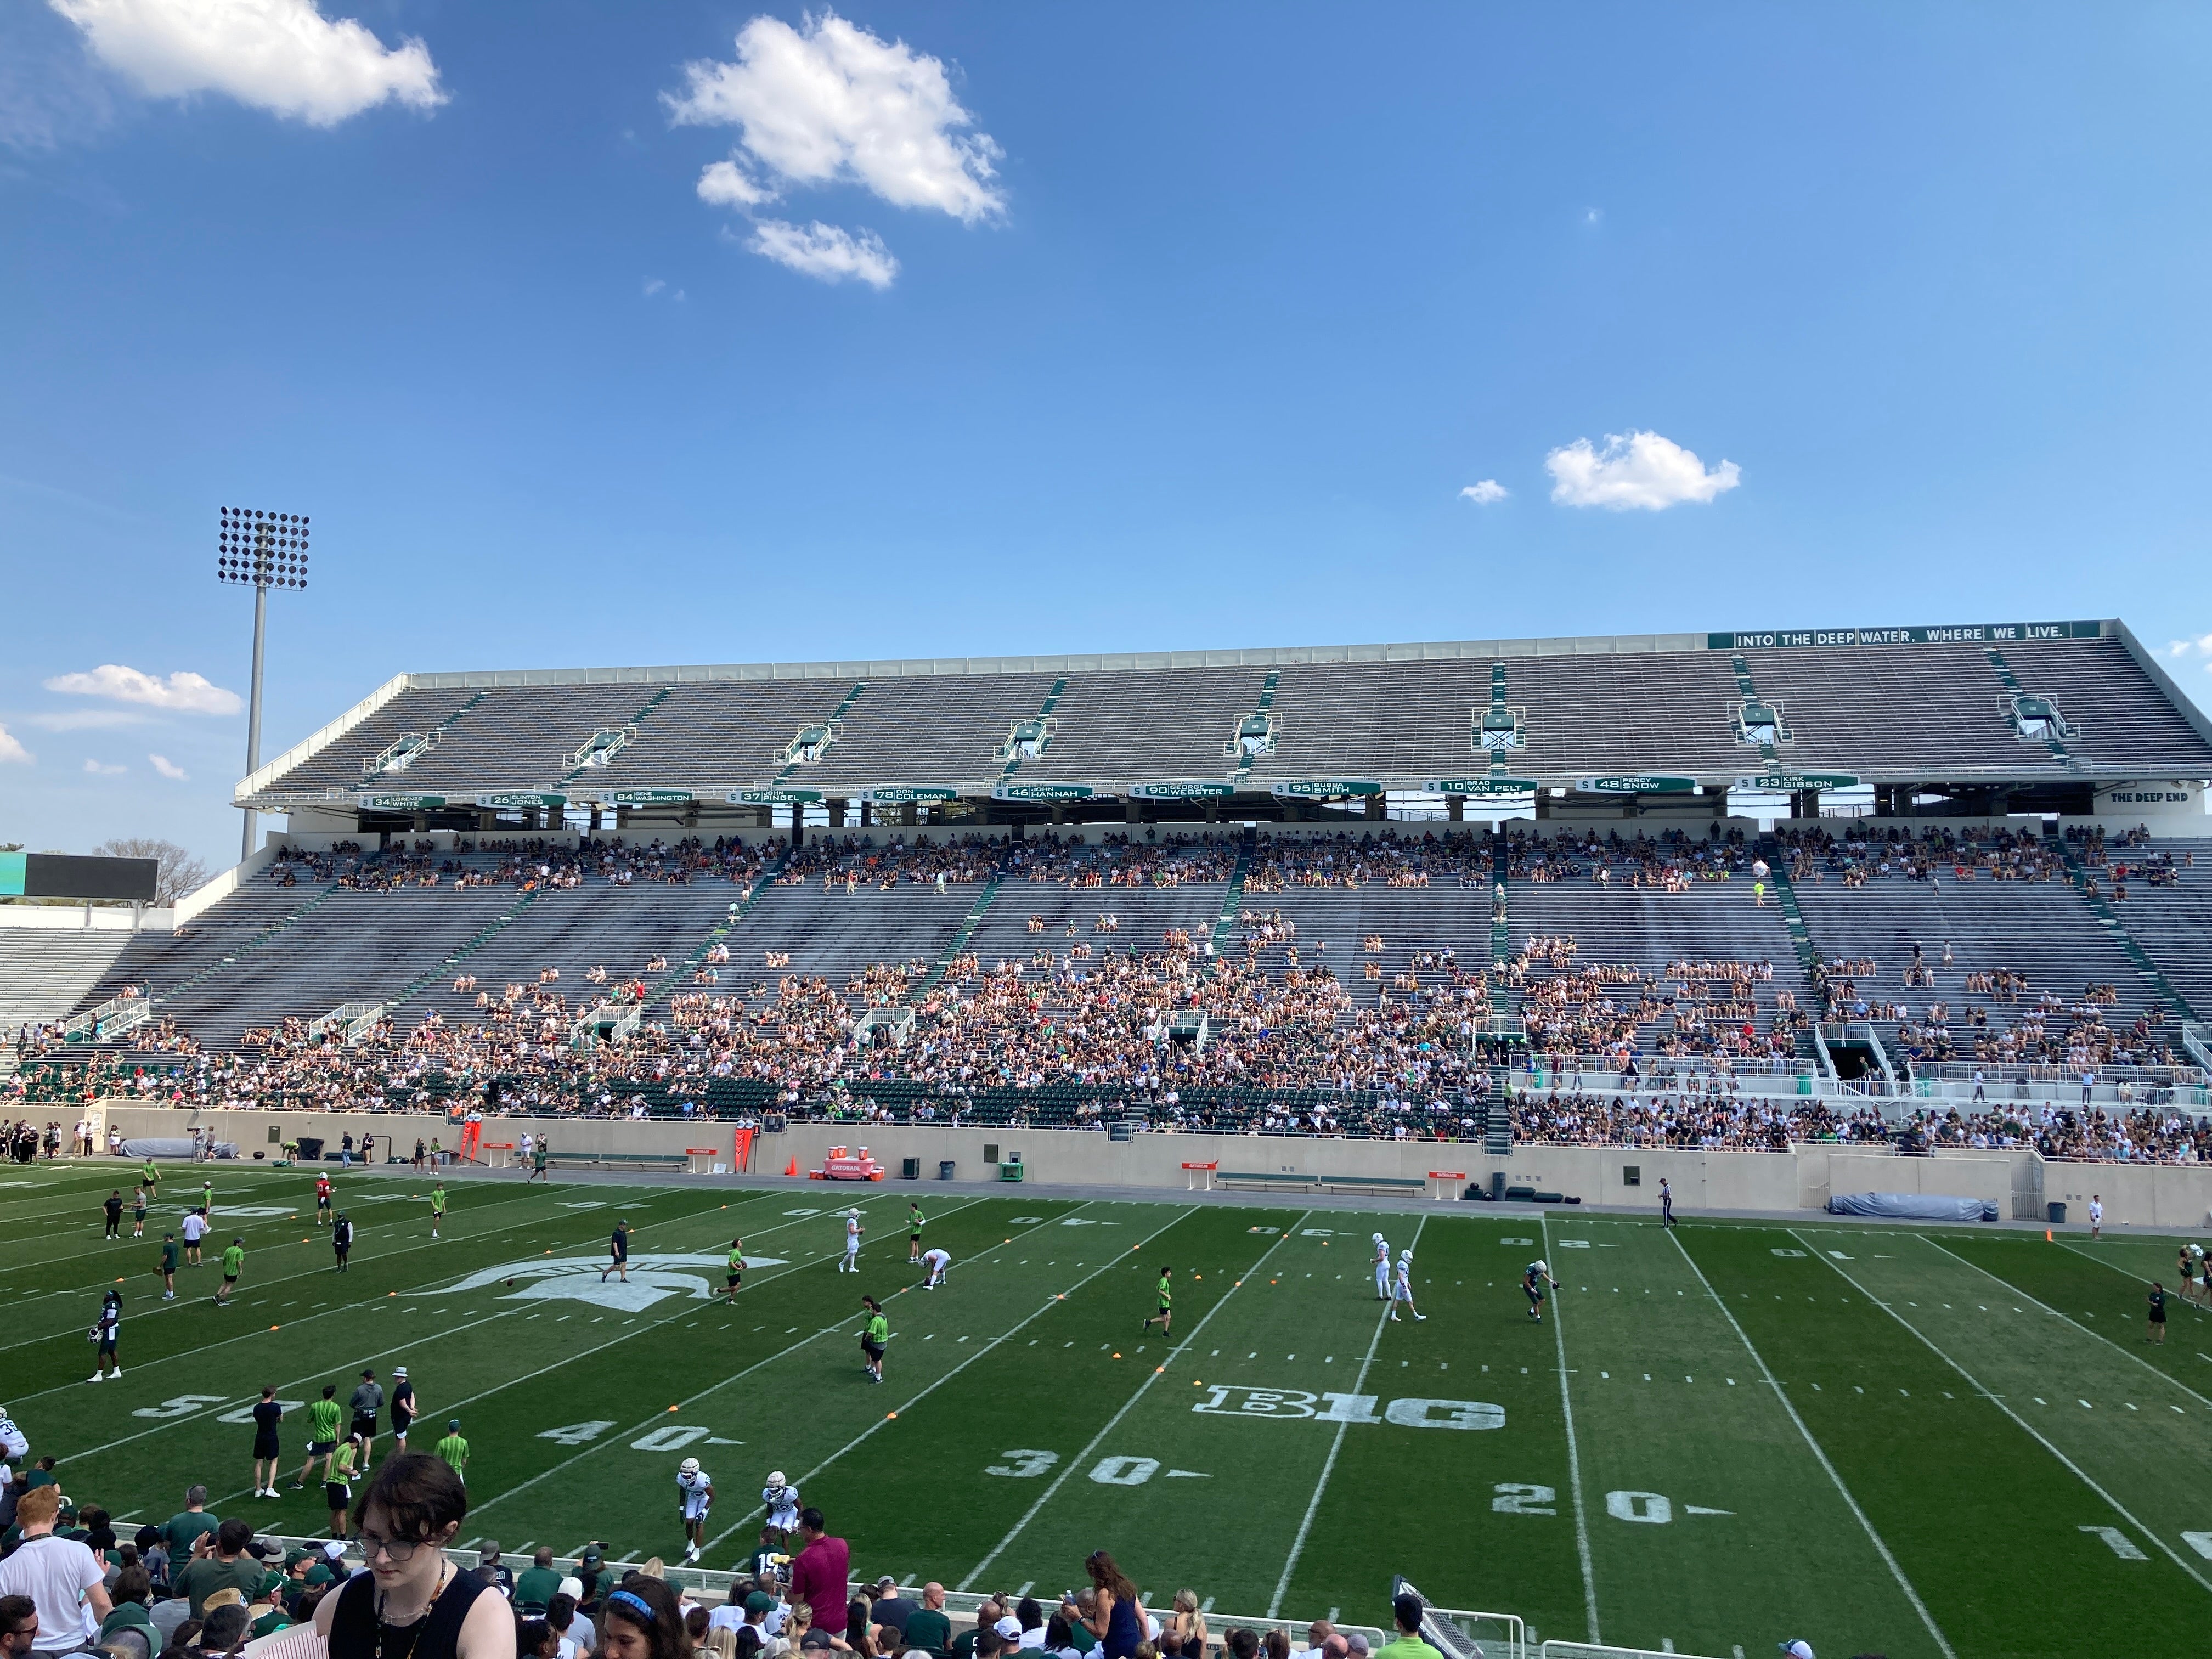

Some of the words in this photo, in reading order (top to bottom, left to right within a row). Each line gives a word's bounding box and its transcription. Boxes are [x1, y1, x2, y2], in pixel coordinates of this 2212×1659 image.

[1738, 634, 1774, 647] INTO
[1782, 634, 1810, 645] THE
[1818, 633, 1855, 644] DEEP
[1860, 630, 1915, 643] WATER,
[1926, 628, 1982, 641] WHERE
[1993, 627, 2016, 639] WE
[2028, 626, 2063, 638] LIVE.
[1582, 781, 1588, 789] S
[1742, 779, 1748, 787] S
[2111, 793, 2132, 803] THE
[2136, 793, 2163, 802] DEEP
[2166, 792, 2188, 802] END
[0, 1420, 18, 1435] 35
